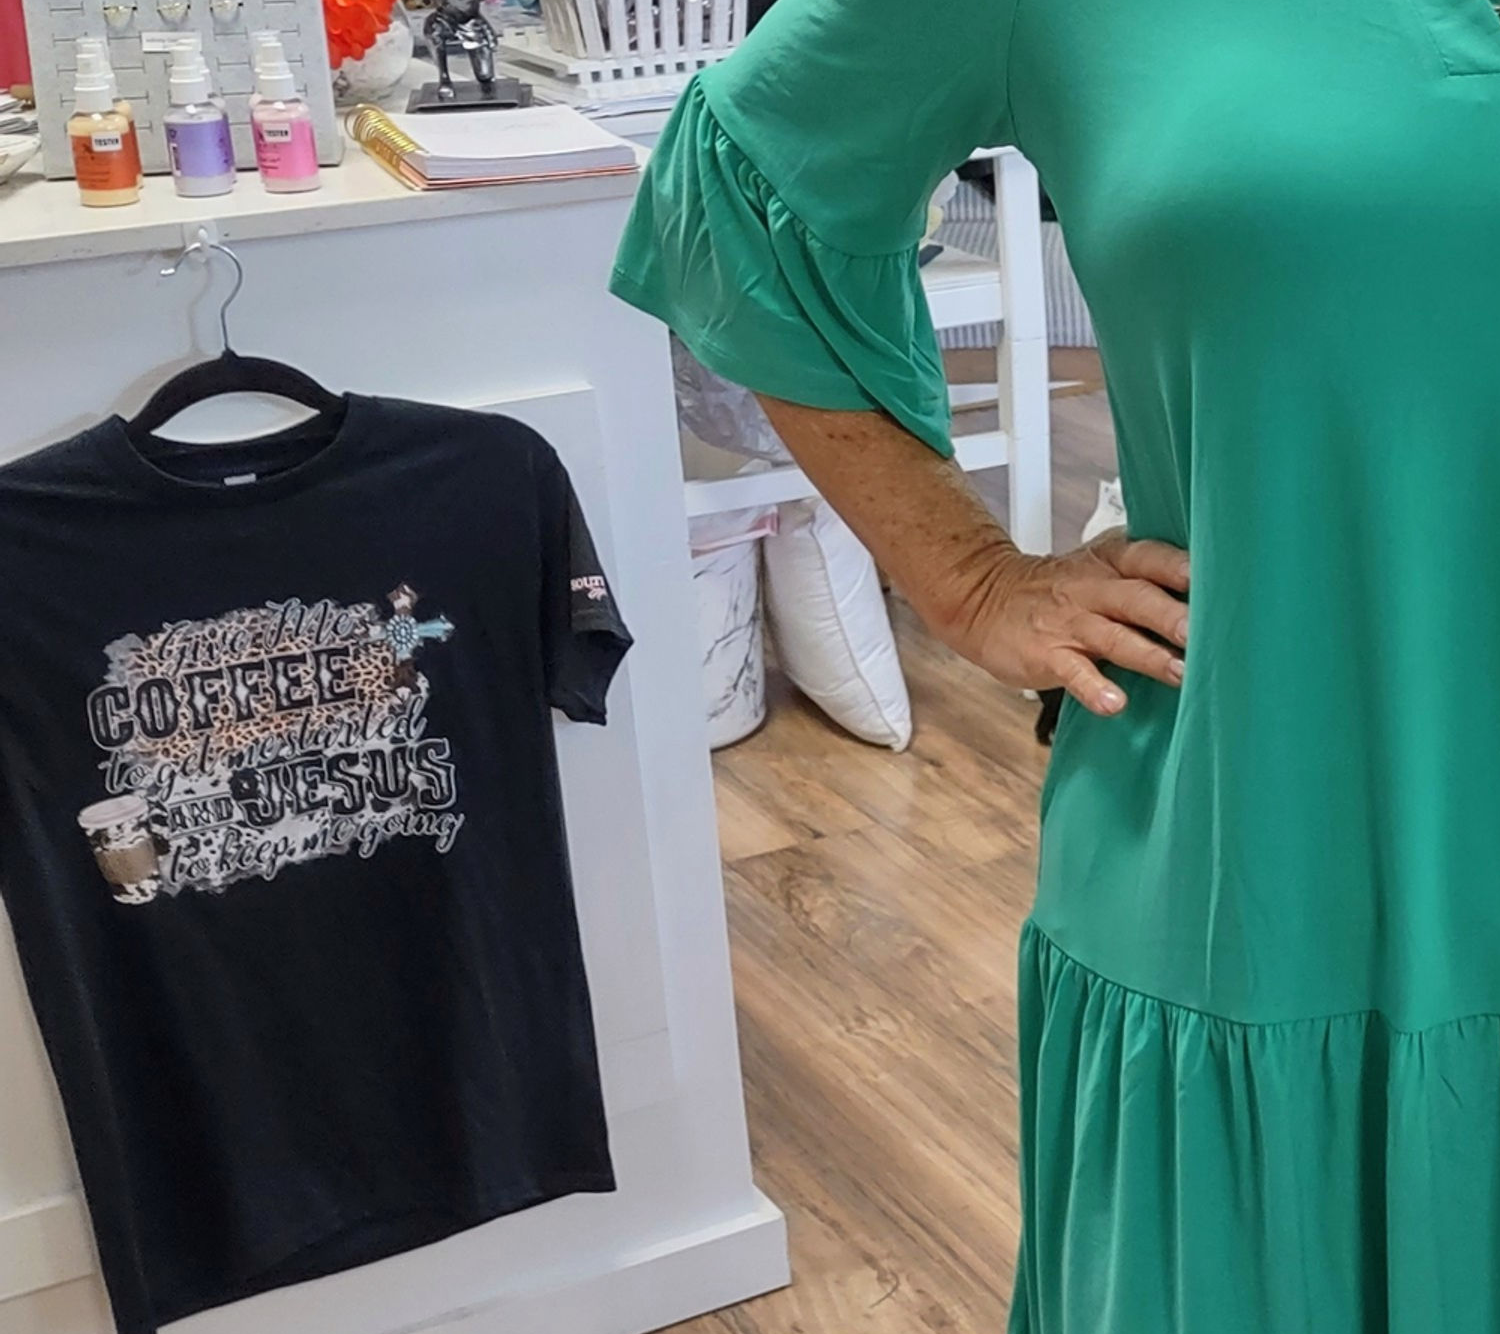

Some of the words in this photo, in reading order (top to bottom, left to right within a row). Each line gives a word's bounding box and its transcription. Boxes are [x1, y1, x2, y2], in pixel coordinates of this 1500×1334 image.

[94, 138, 119, 146] TESTER
[264, 129, 289, 137] TESTER
[157, 619, 248, 678] Give
[264, 597, 357, 649] Me
[87, 645, 359, 750] COFFEE
[98, 749, 150, 794] to
[155, 733, 216, 801] get
[222, 733, 280, 769] me
[284, 694, 428, 758] started
[169, 795, 235, 833] AND
[238, 737, 457, 827] JESUS
[170, 839, 211, 883] to
[216, 827, 290, 881] keep
[301, 816, 350, 851] me
[357, 810, 465, 859] going
